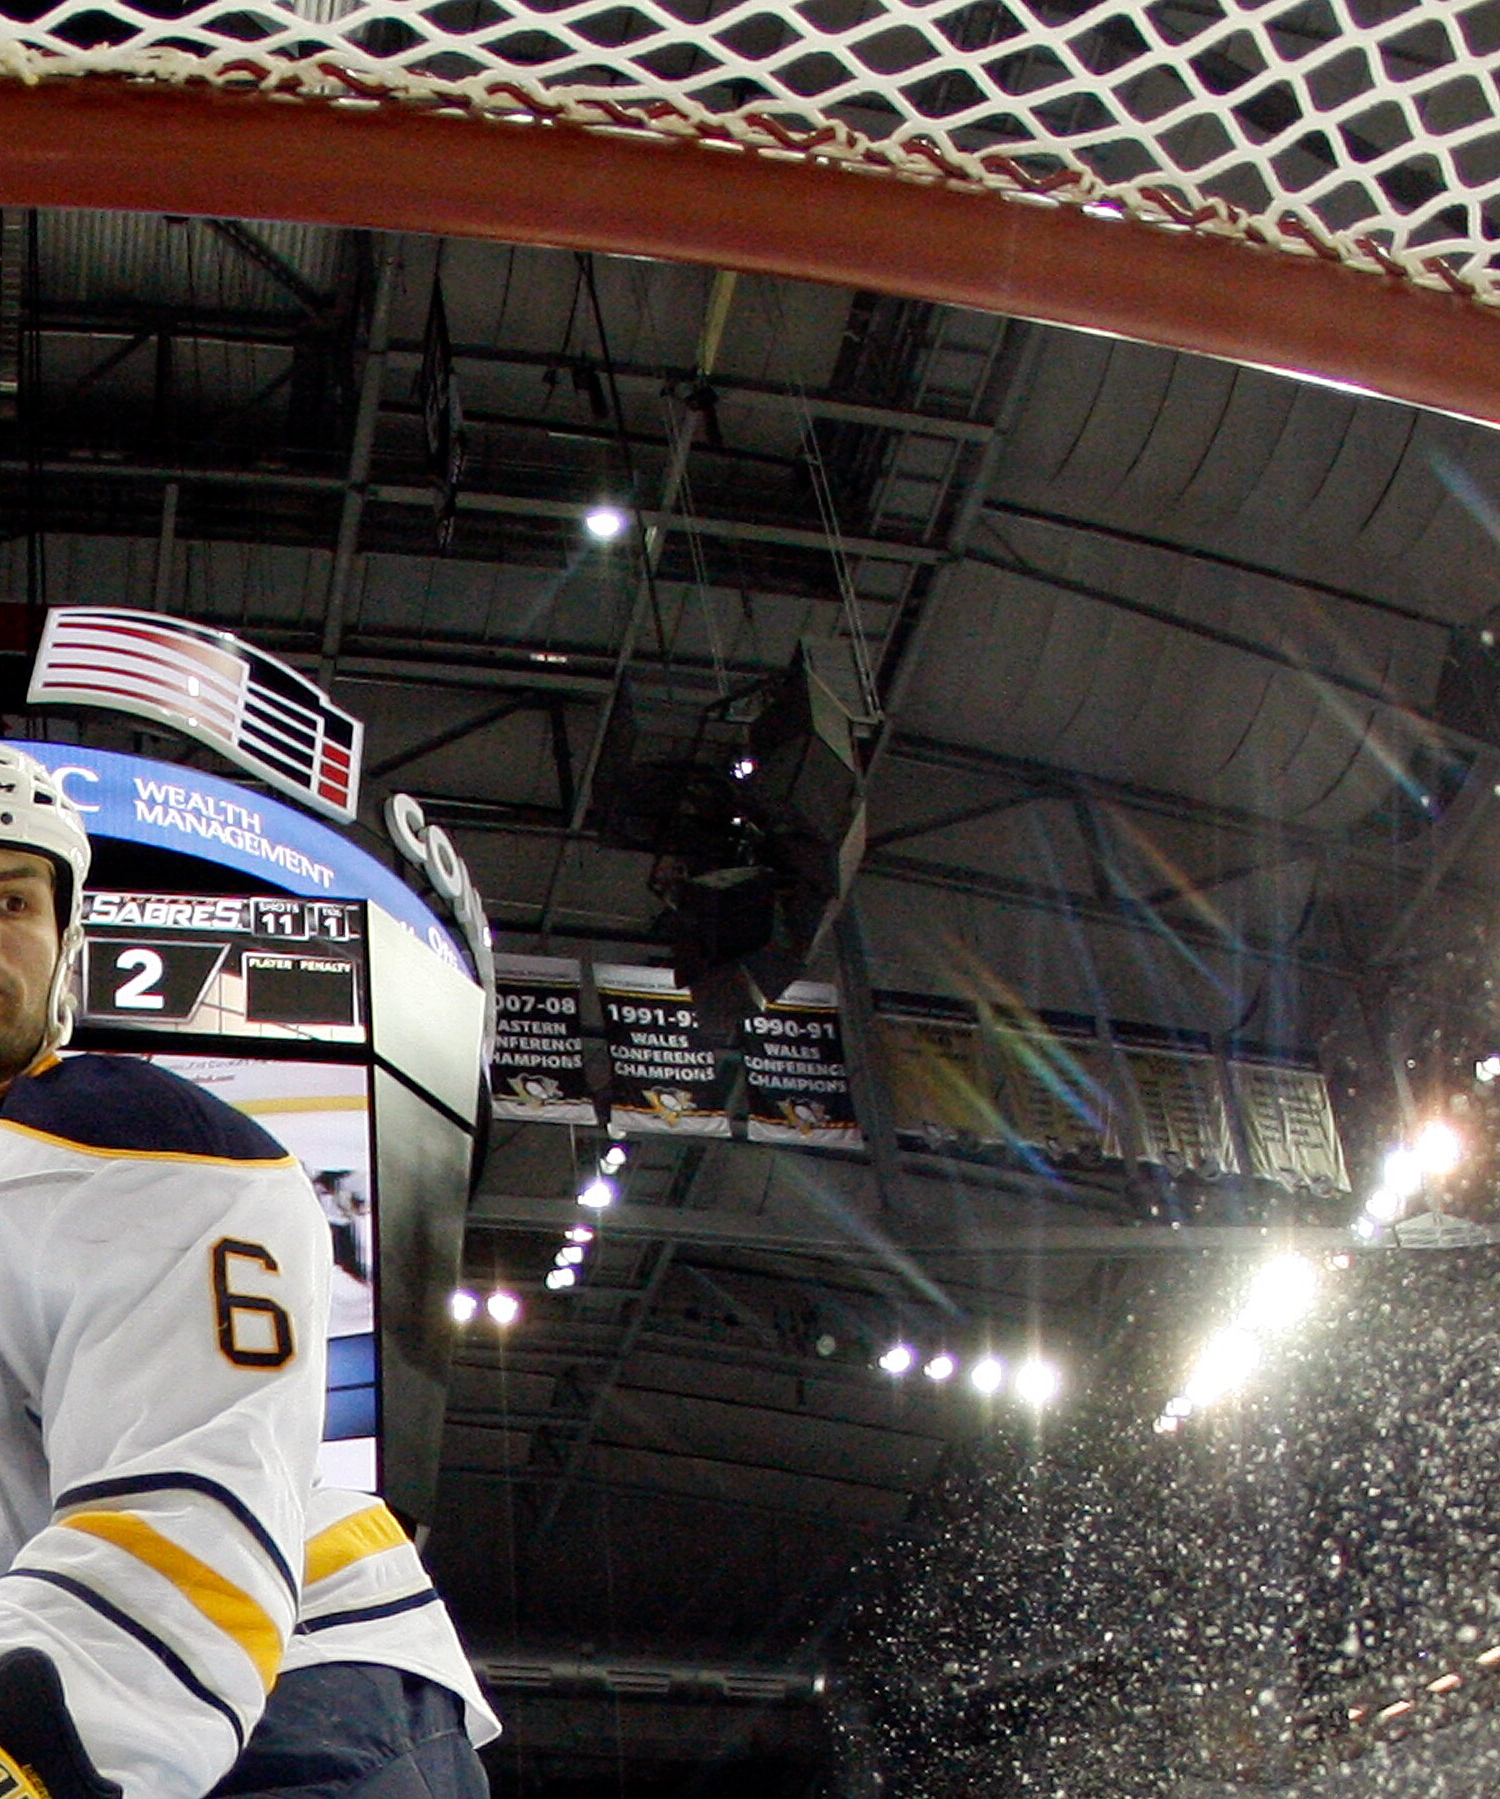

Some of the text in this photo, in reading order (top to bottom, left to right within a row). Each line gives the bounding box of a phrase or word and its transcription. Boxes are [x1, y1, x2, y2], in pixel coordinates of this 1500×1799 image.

[133, 777, 261, 834] WEALTH
[134, 799, 335, 889] MANAGEMENT
[90, 896, 242, 928] SABRES
[258, 901, 300, 914] SHOTS
[261, 913, 292, 935] 11
[323, 917, 337, 937] 1
[249, 957, 352, 973] PLAYER PENALTY
[114, 949, 164, 1009] 2
[495, 994, 577, 1016] 007-08
[497, 1018, 568, 1037] ASTERN
[607, 1004, 698, 1029] 1991-9
[743, 1017, 836, 1040] 1990-91
[495, 1035, 583, 1053] NFERENCE
[629, 1031, 689, 1049] WALES
[492, 1051, 584, 1070] HAMPIONS
[608, 1044, 716, 1066] CONFERENCE
[763, 1043, 821, 1061] WALES
[613, 1061, 716, 1082] CHAMPIONS
[747, 1071, 848, 1094] CHAMPIONS
[210, 1236, 298, 1371] 6
